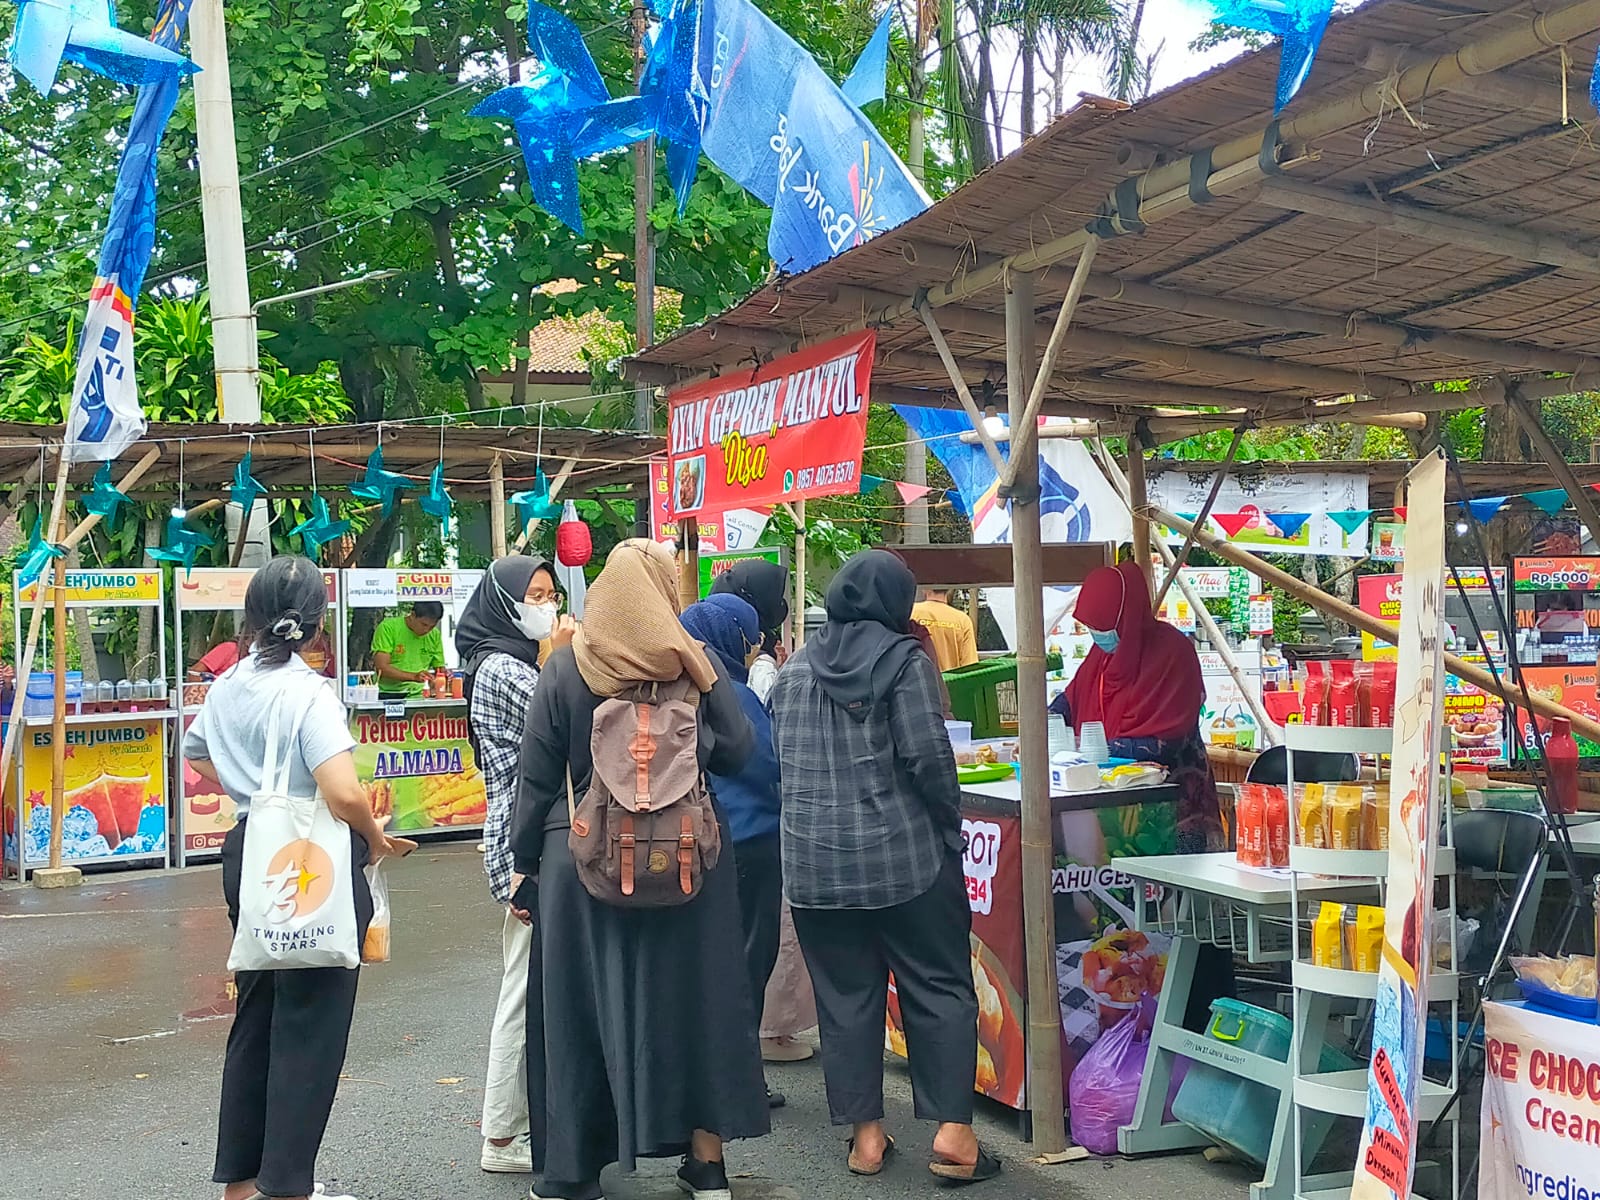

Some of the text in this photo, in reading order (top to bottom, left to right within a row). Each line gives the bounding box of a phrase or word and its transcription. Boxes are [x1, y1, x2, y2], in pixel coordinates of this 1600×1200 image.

[709, 378, 782, 445] GEPREK
[777, 353, 862, 428] MANTUL
[697, 524, 718, 536] ULIT
[65, 575, 82, 587] EH
[85, 575, 136, 590] JUMBO
[411, 572, 452, 584] Gulu
[397, 586, 453, 596] MADA
[357, 713, 468, 744] Telur Gulun
[34, 728, 146, 747] ES EH JUMBO
[375, 748, 464, 776] ALMADA
[1053, 868, 1092, 889] AHU
[254, 926, 335, 941] TWINKLING
[270, 938, 317, 952] STARS
